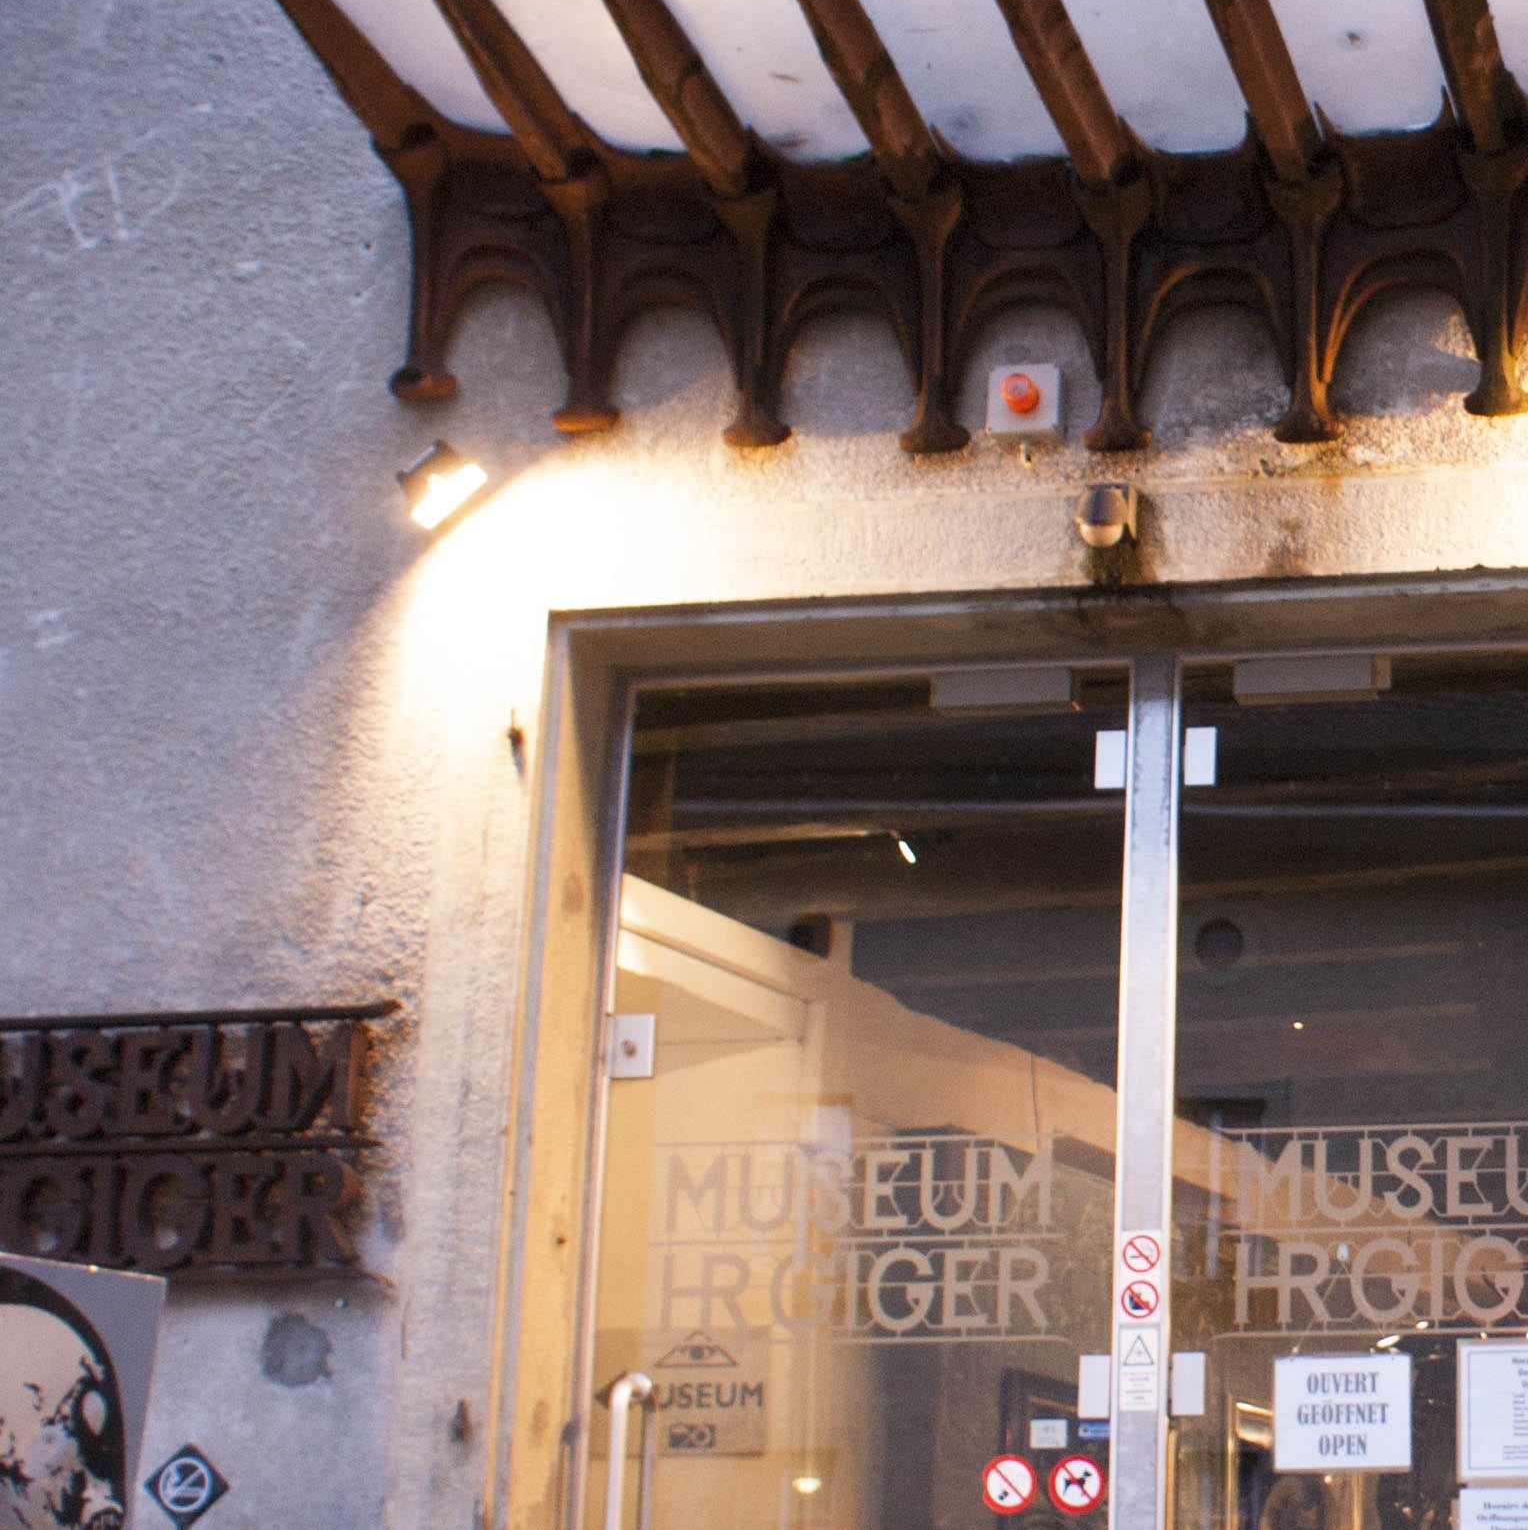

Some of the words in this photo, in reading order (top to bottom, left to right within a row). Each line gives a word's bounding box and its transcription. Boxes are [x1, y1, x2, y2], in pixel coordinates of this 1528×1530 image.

[666, 1144, 1054, 1233] MUSEUM
[655, 1381, 764, 1410] USEUM
[1306, 1371, 1379, 1394] OUVERT
[1297, 1399, 1389, 1425] GEÖFFNET
[1318, 1433, 1367, 1456] OPEN
